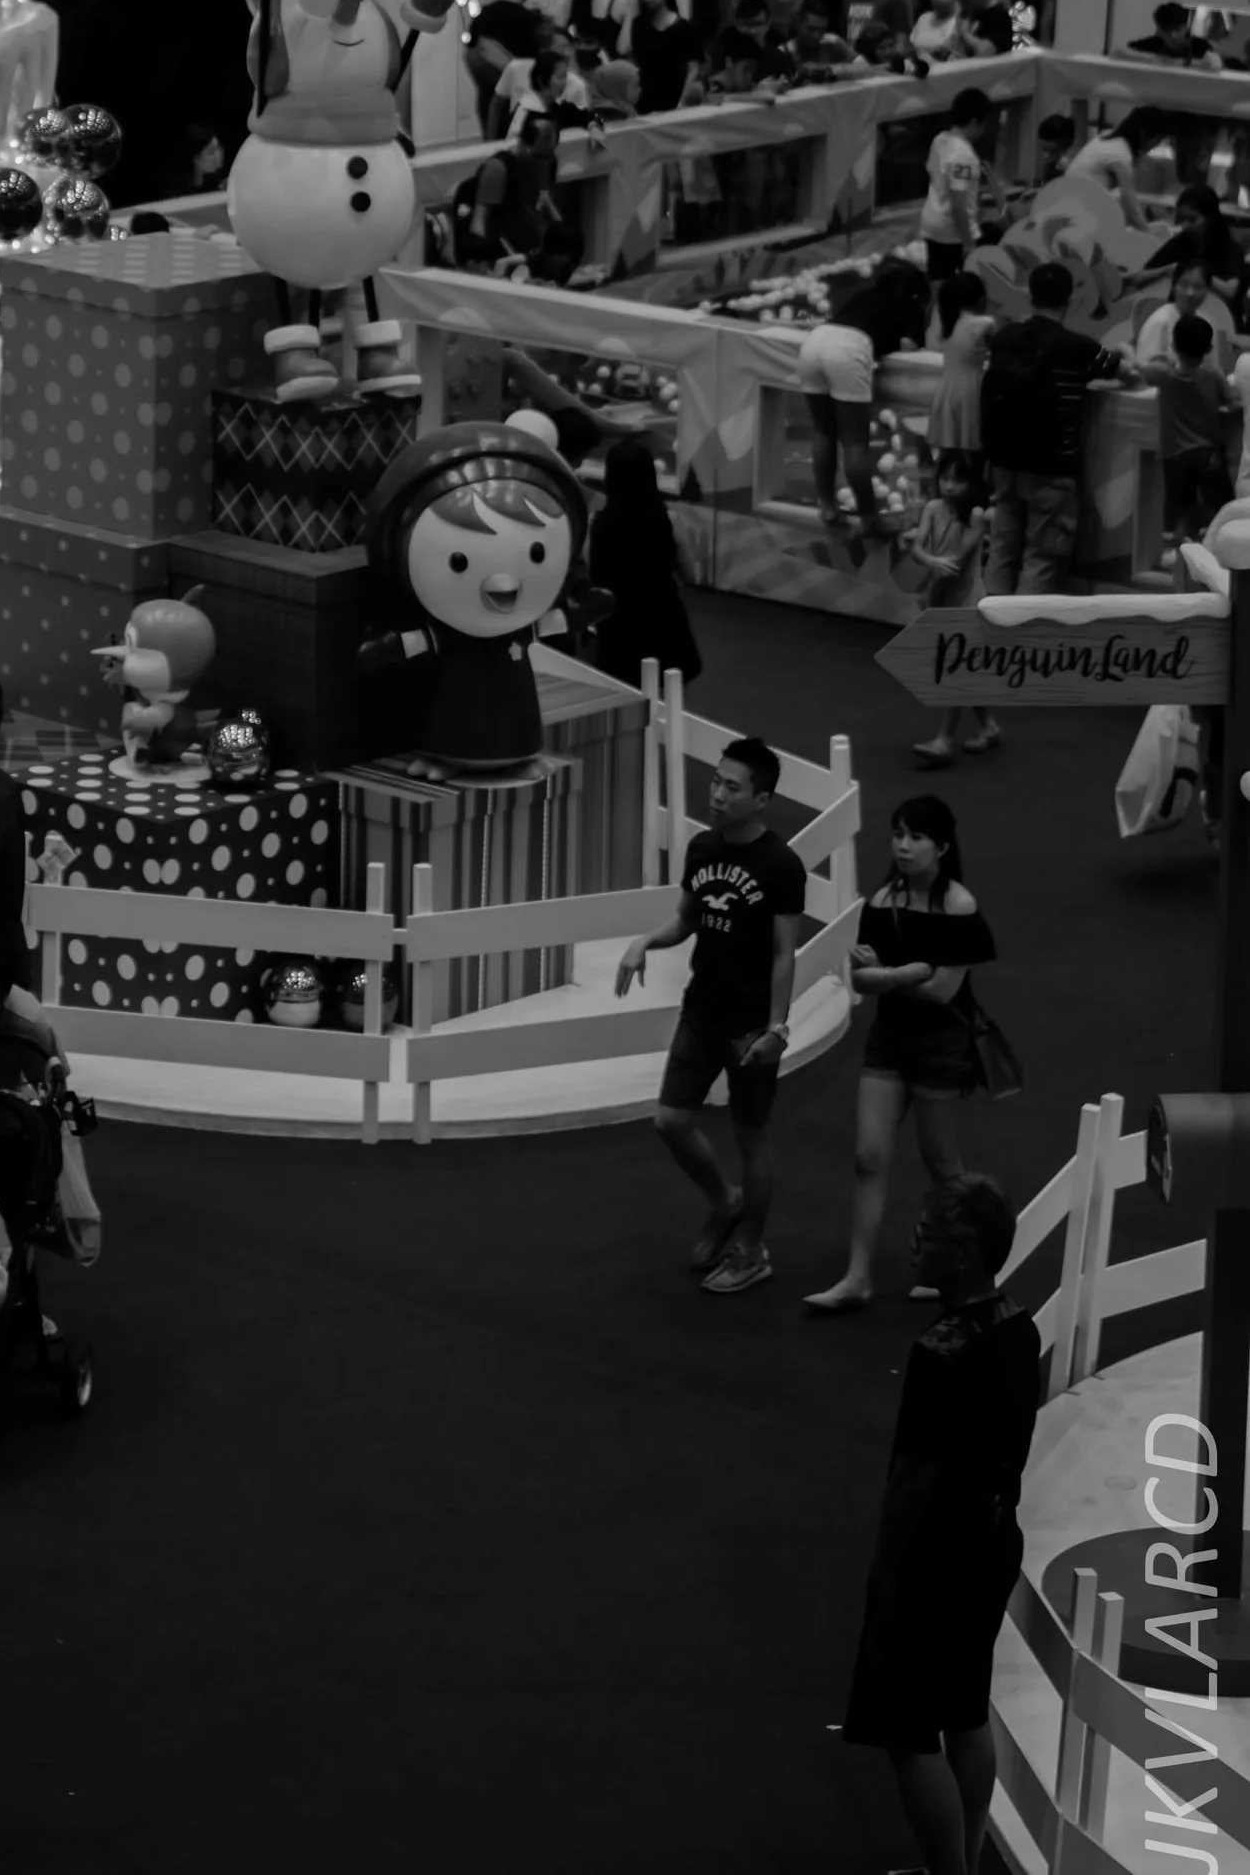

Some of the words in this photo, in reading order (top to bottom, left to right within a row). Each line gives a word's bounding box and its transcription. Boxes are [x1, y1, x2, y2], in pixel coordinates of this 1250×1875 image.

[934, 632, 1097, 689] Penguin
[1094, 634, 1196, 682] Land
[690, 861, 764, 906] HOLLISTER
[701, 912, 733, 933] 1922
